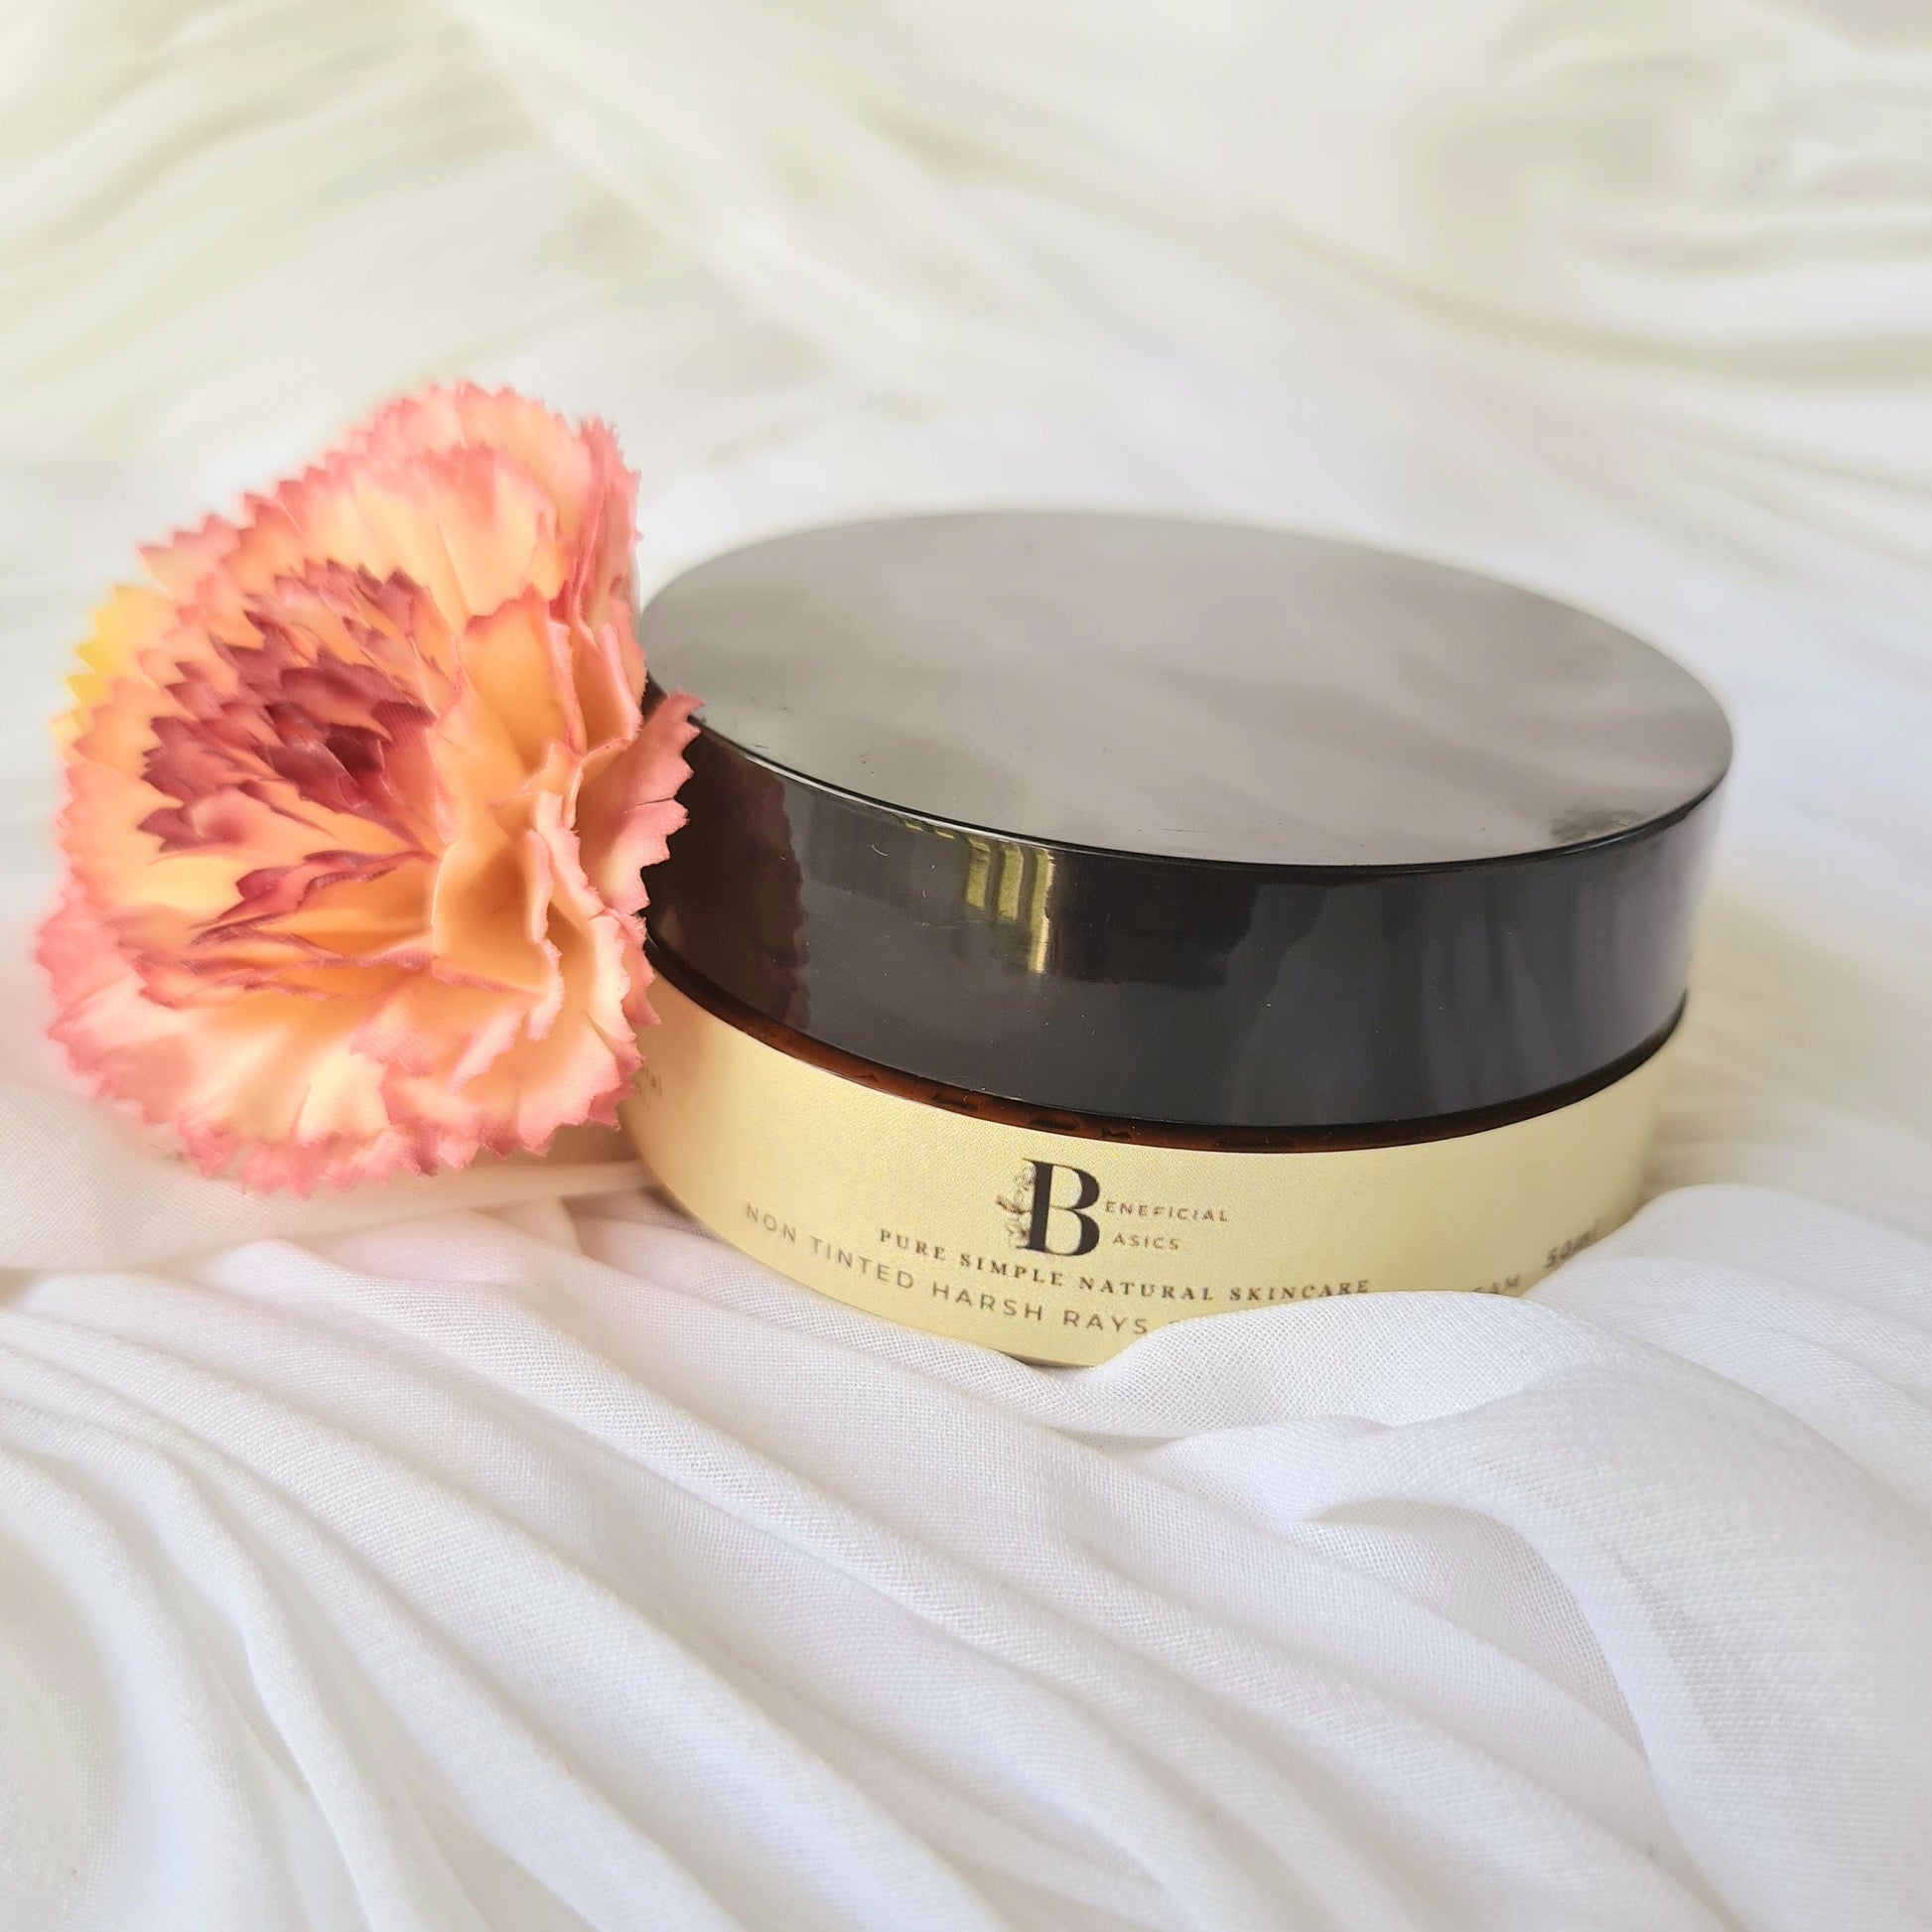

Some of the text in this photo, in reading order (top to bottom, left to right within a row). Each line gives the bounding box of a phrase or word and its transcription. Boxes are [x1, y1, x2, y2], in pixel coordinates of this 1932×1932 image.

[746, 1201, 796, 1243] NON
[810, 1235, 914, 1290] TINTED
[932, 1280, 1043, 1321] HARSH
[1062, 1309, 1149, 1335] RAYS
[880, 1228, 1370, 1302] PURE SIMPLE NATURAL SKINCARE
